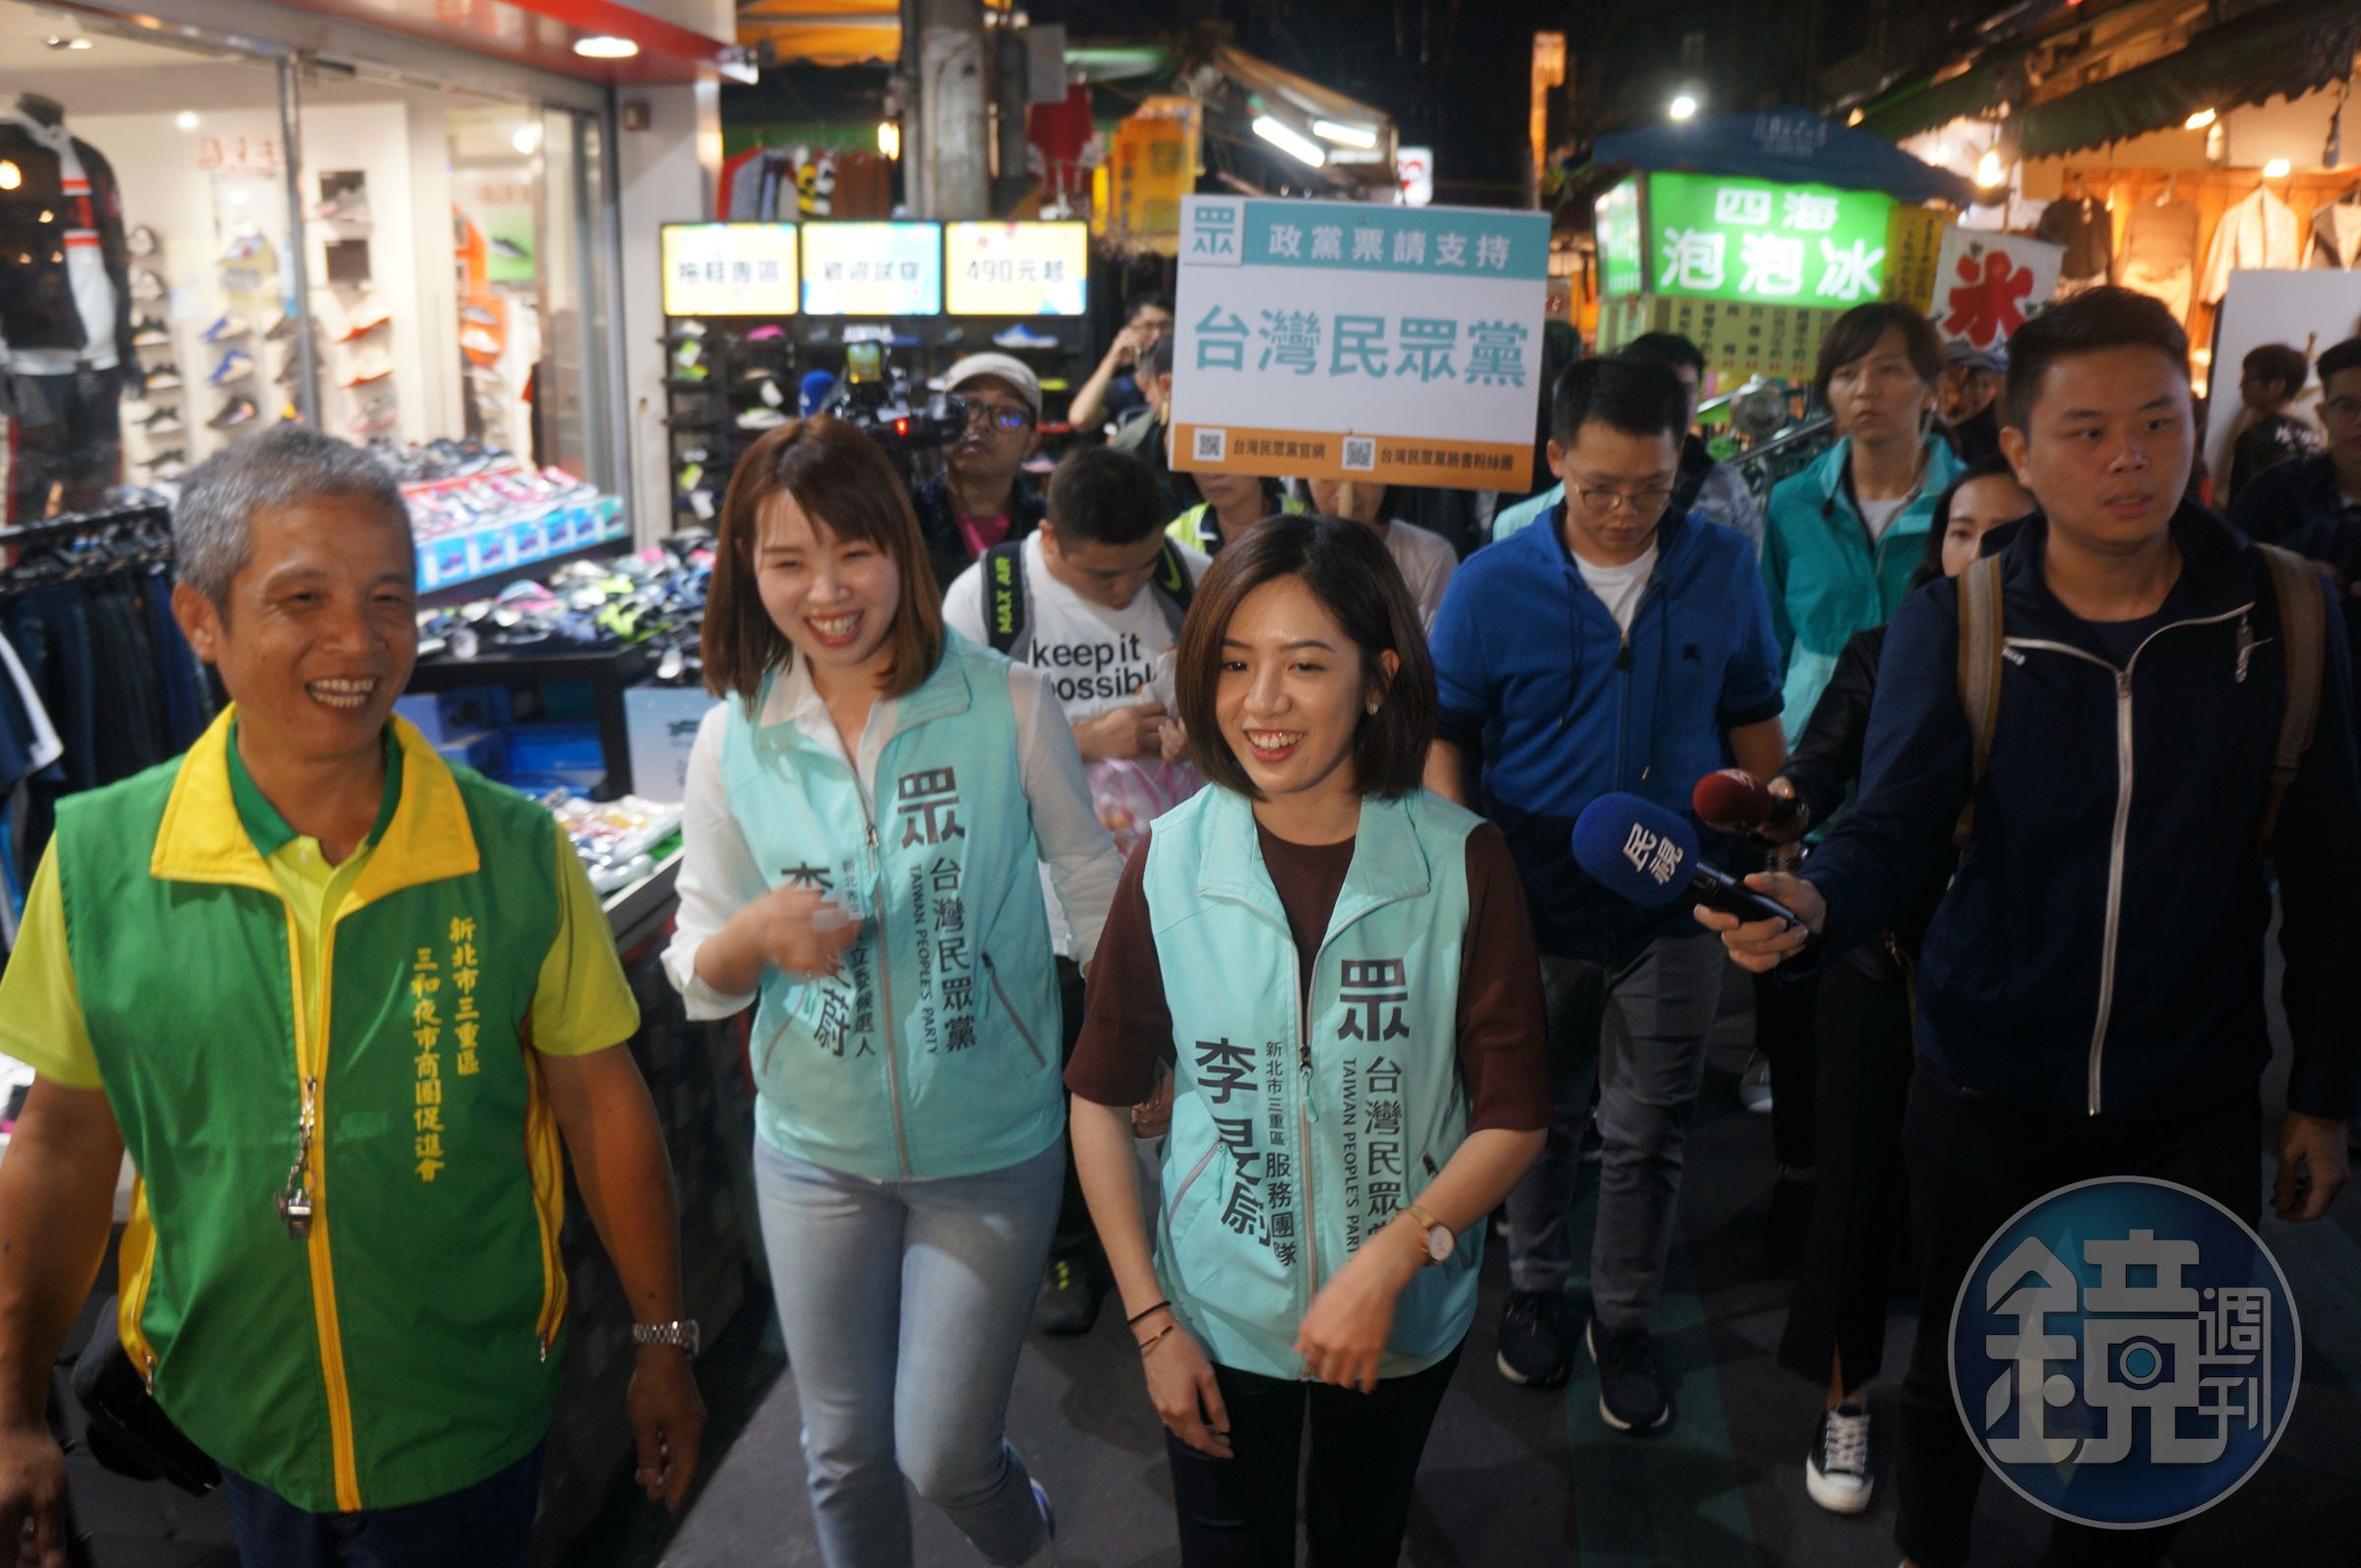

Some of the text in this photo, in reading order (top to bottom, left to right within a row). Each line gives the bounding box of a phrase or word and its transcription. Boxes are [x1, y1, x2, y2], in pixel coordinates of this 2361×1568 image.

[1268, 222, 1512, 271] 政黨票請支持
[1715, 186, 1840, 232] 四海
[965, 259, 1065, 283] 490元起
[1660, 226, 1885, 301] 泡泡冰
[1193, 304, 1529, 390] 台灣民眾黨
[995, 556, 1013, 634] MAX AIR
[1033, 633, 1141, 674] keep it
[1052, 662, 1157, 702] ossibl
[1623, 821, 1684, 885] 民視
[909, 864, 927, 926] TAIWAN
[922, 1006, 938, 1055] PARTY
[930, 856, 977, 1054] 台灣民眾黨
[449, 916, 480, 1076] 新北市三重區
[1342, 1056, 1362, 1257] TAIWAN PEOPLE'S PART
